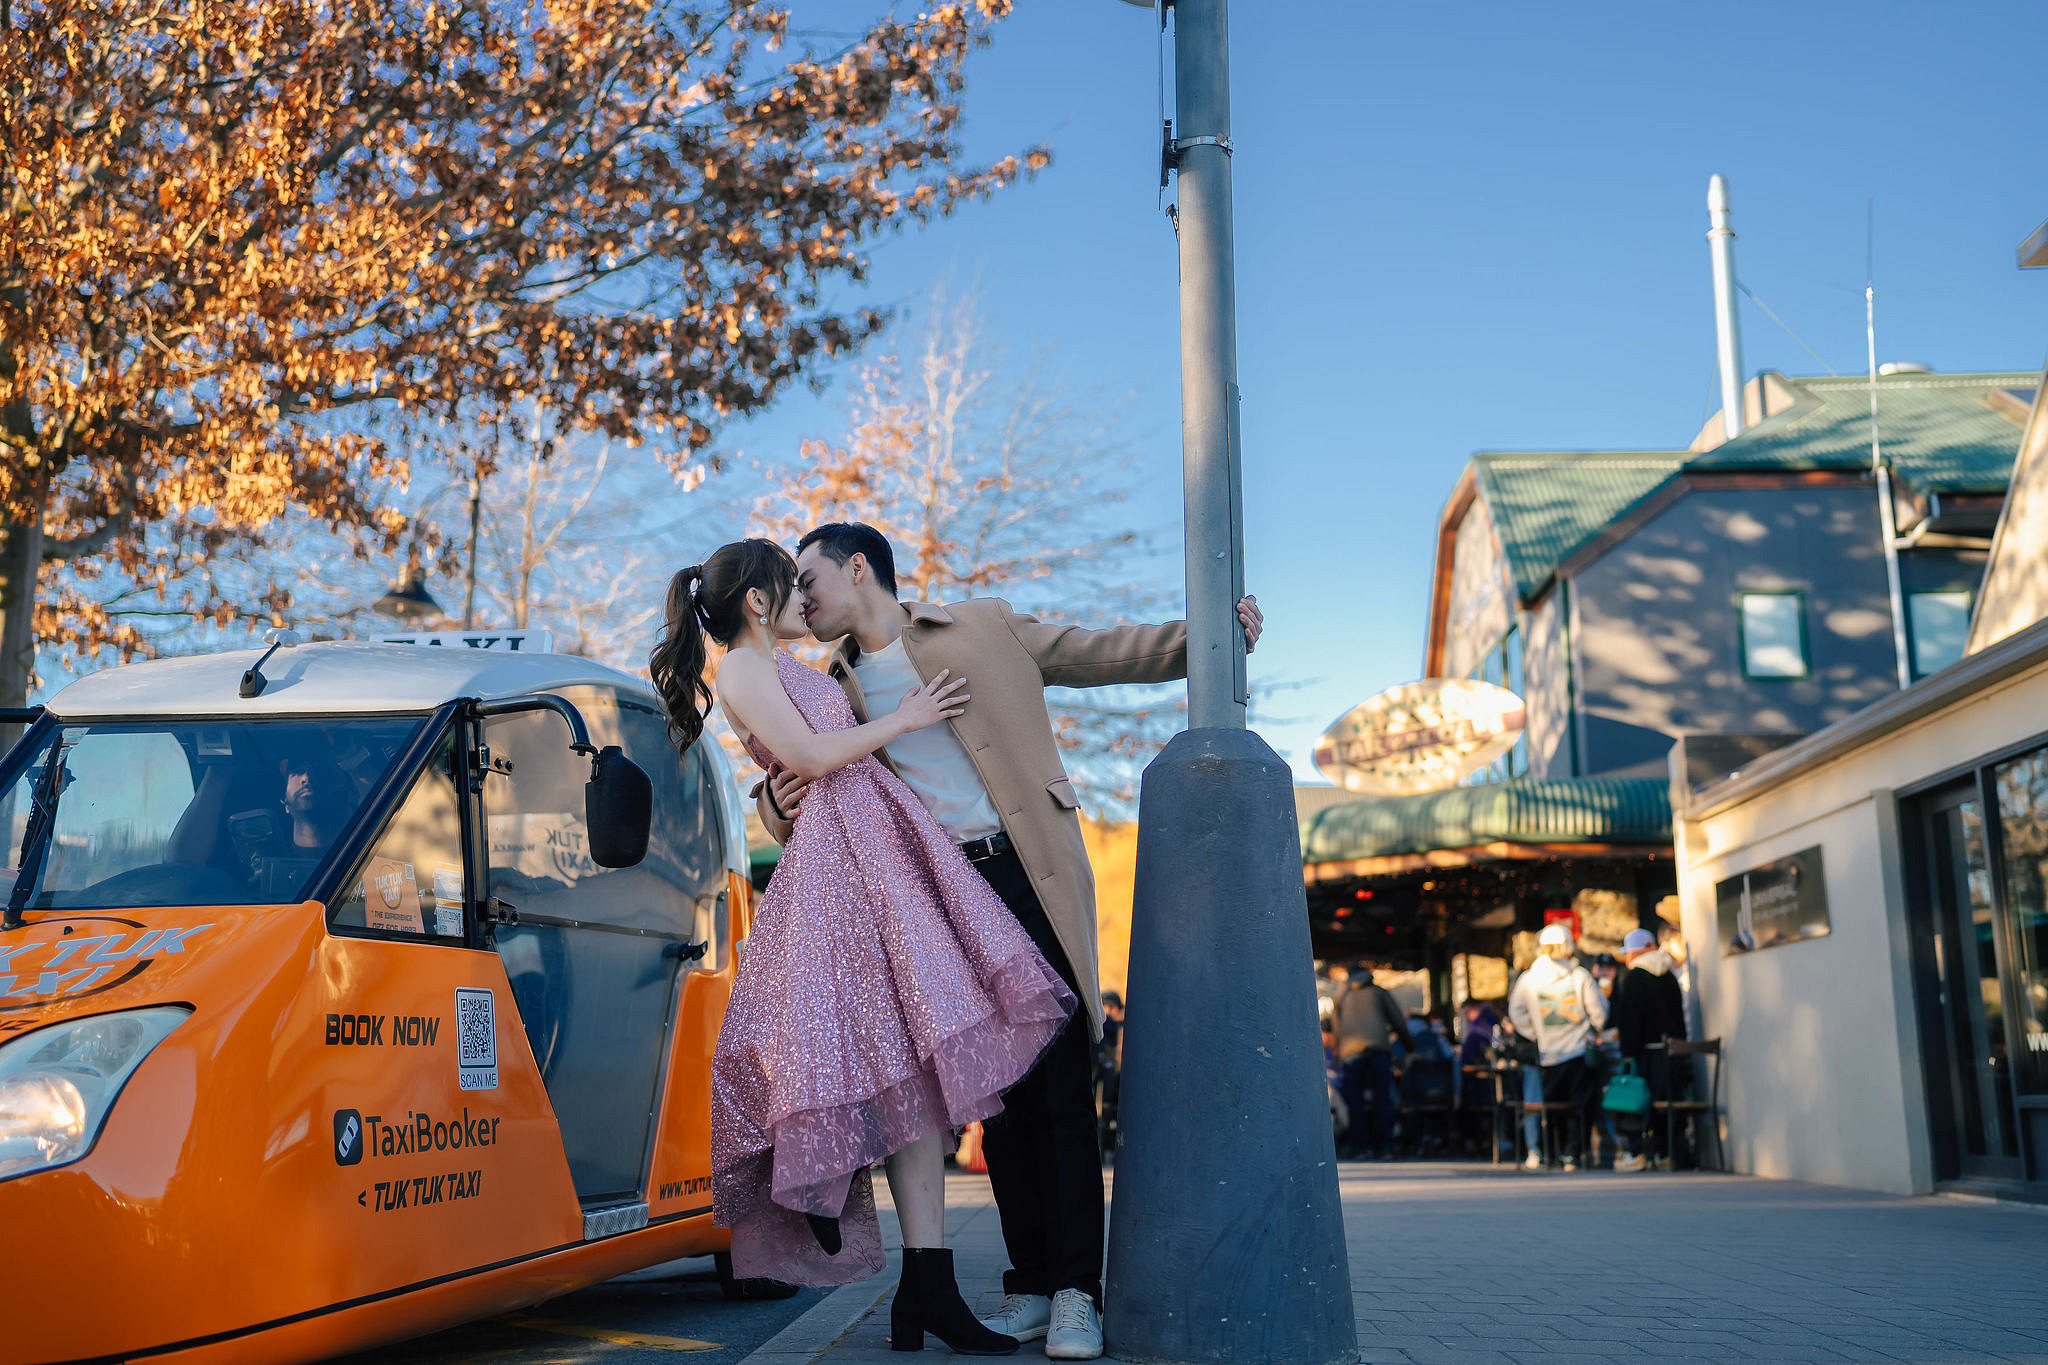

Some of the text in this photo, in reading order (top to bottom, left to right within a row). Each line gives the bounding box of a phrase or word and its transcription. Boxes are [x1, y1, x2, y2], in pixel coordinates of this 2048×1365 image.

[374, 871, 404, 890] TUK TUK
[384, 886, 401, 902] TAXI
[374, 911, 384, 920] THE
[43, 923, 216, 968] TUK
[325, 1014, 441, 1046] BOOK NOW
[460, 1073, 497, 1088] SCAN ME
[365, 1107, 501, 1157] TaxiBooker
[374, 1170, 482, 1213] TUK TUK TAXI
